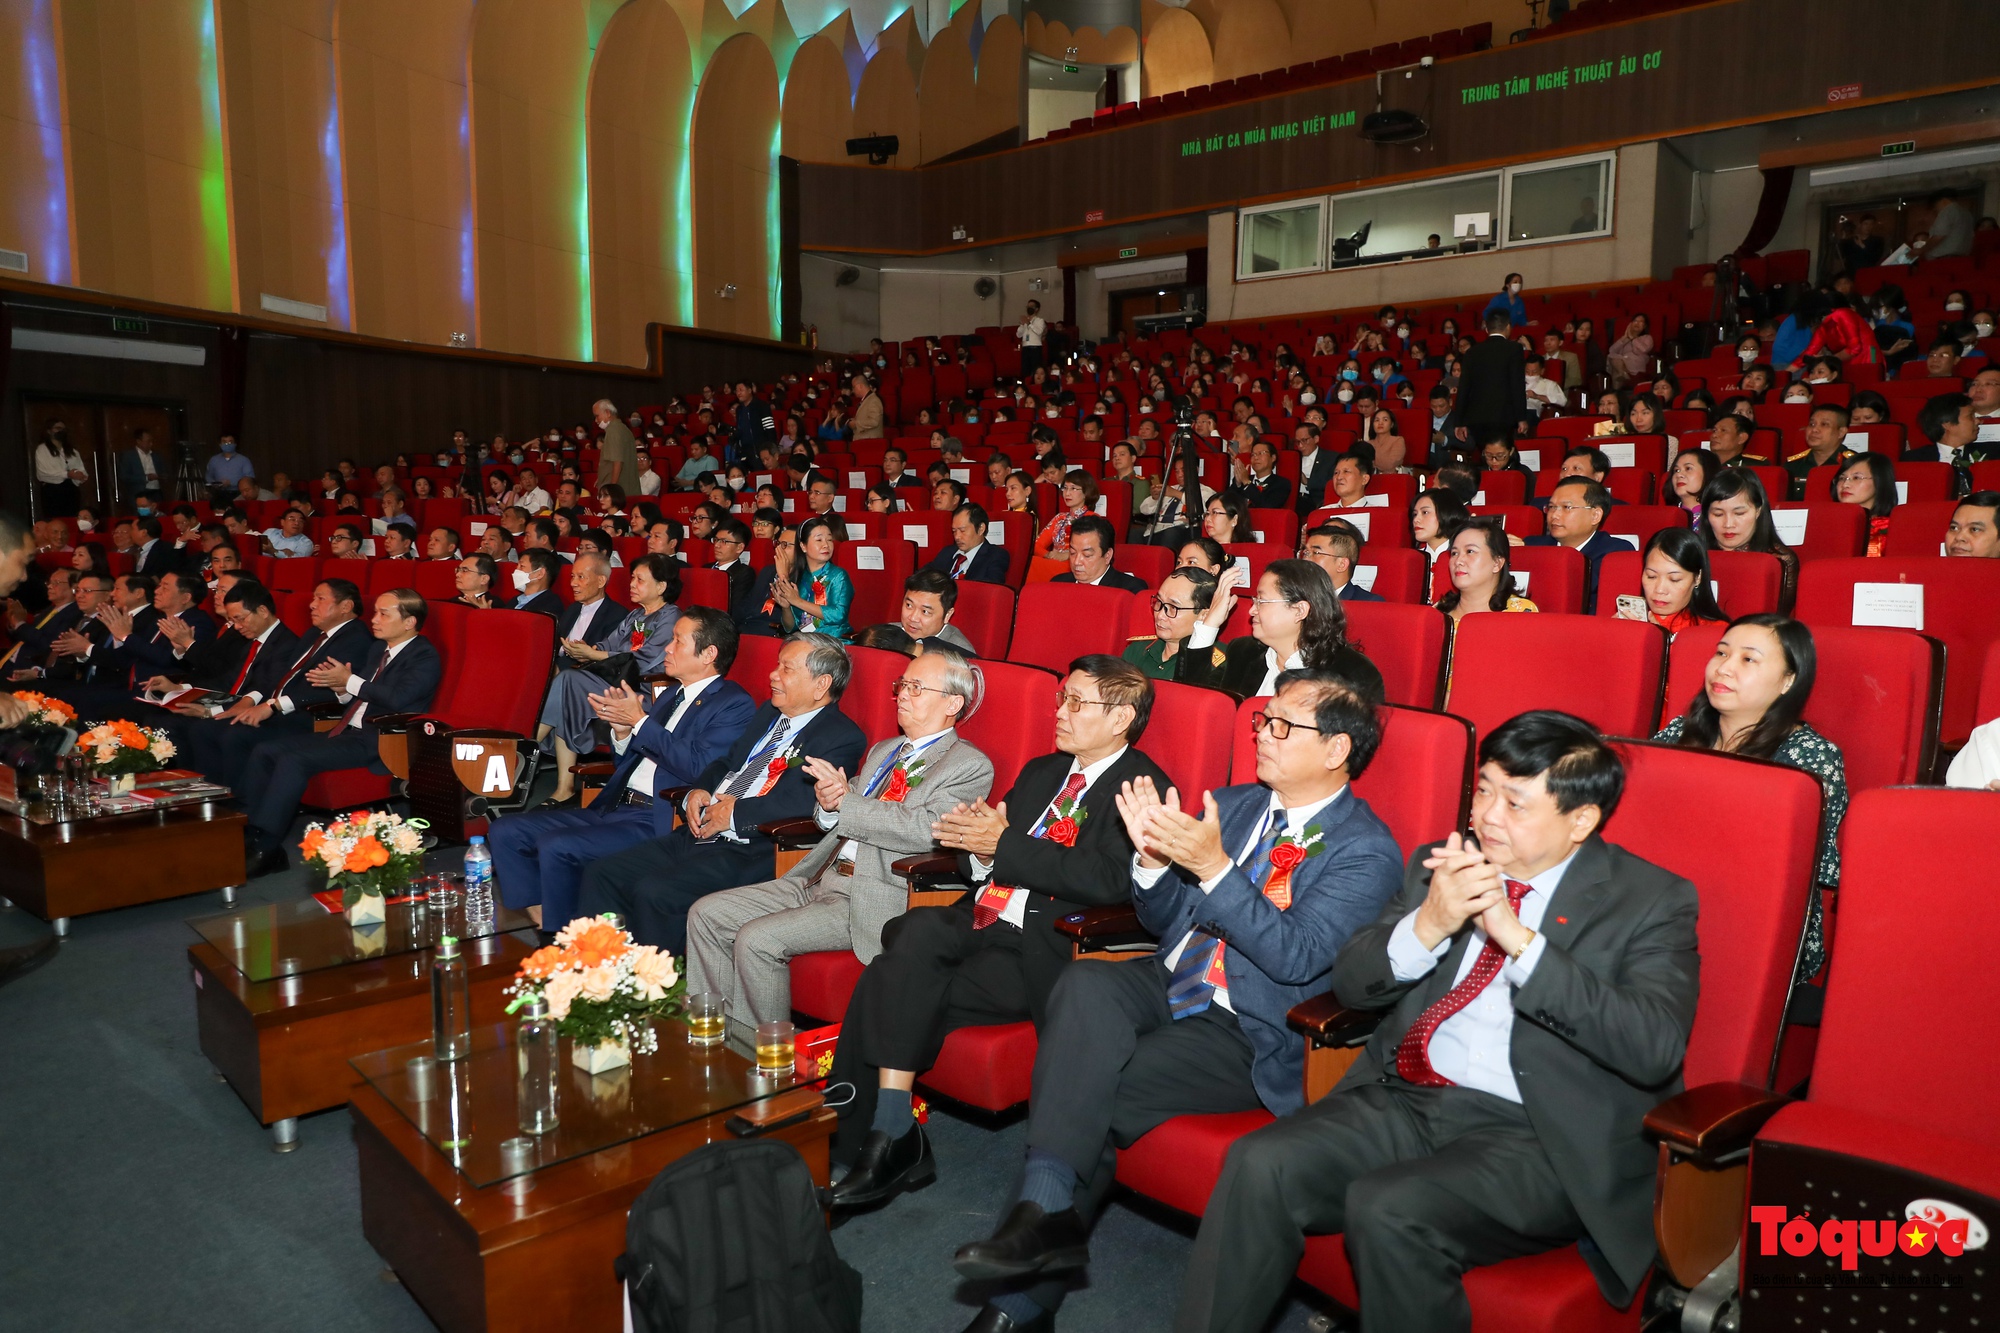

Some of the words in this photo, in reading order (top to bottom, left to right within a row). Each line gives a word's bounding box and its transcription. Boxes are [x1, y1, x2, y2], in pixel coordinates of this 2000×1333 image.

[1462, 84, 1500, 104] TRUNG
[1504, 76, 1530, 96] TÂM
[1536, 66, 1569, 90] NGHỆ
[1574, 59, 1613, 83] THUẬT
[1619, 55, 1637, 76] ÂU
[1643, 50, 1662, 70] CƠ
[1182, 138, 1202, 156] NHÀ
[1206, 133, 1223, 152] HÁT
[1227, 132, 1240, 148] CA
[1244, 125, 1266, 145] MÚA
[1270, 122, 1298, 141] NHẠC
[1302, 115, 1326, 136] VIỆT
[1330, 110, 1356, 129] NAM
[1884, 144, 1911, 153] EXIT
[456, 744, 484, 760] VIP
[482, 755, 511, 793] A
